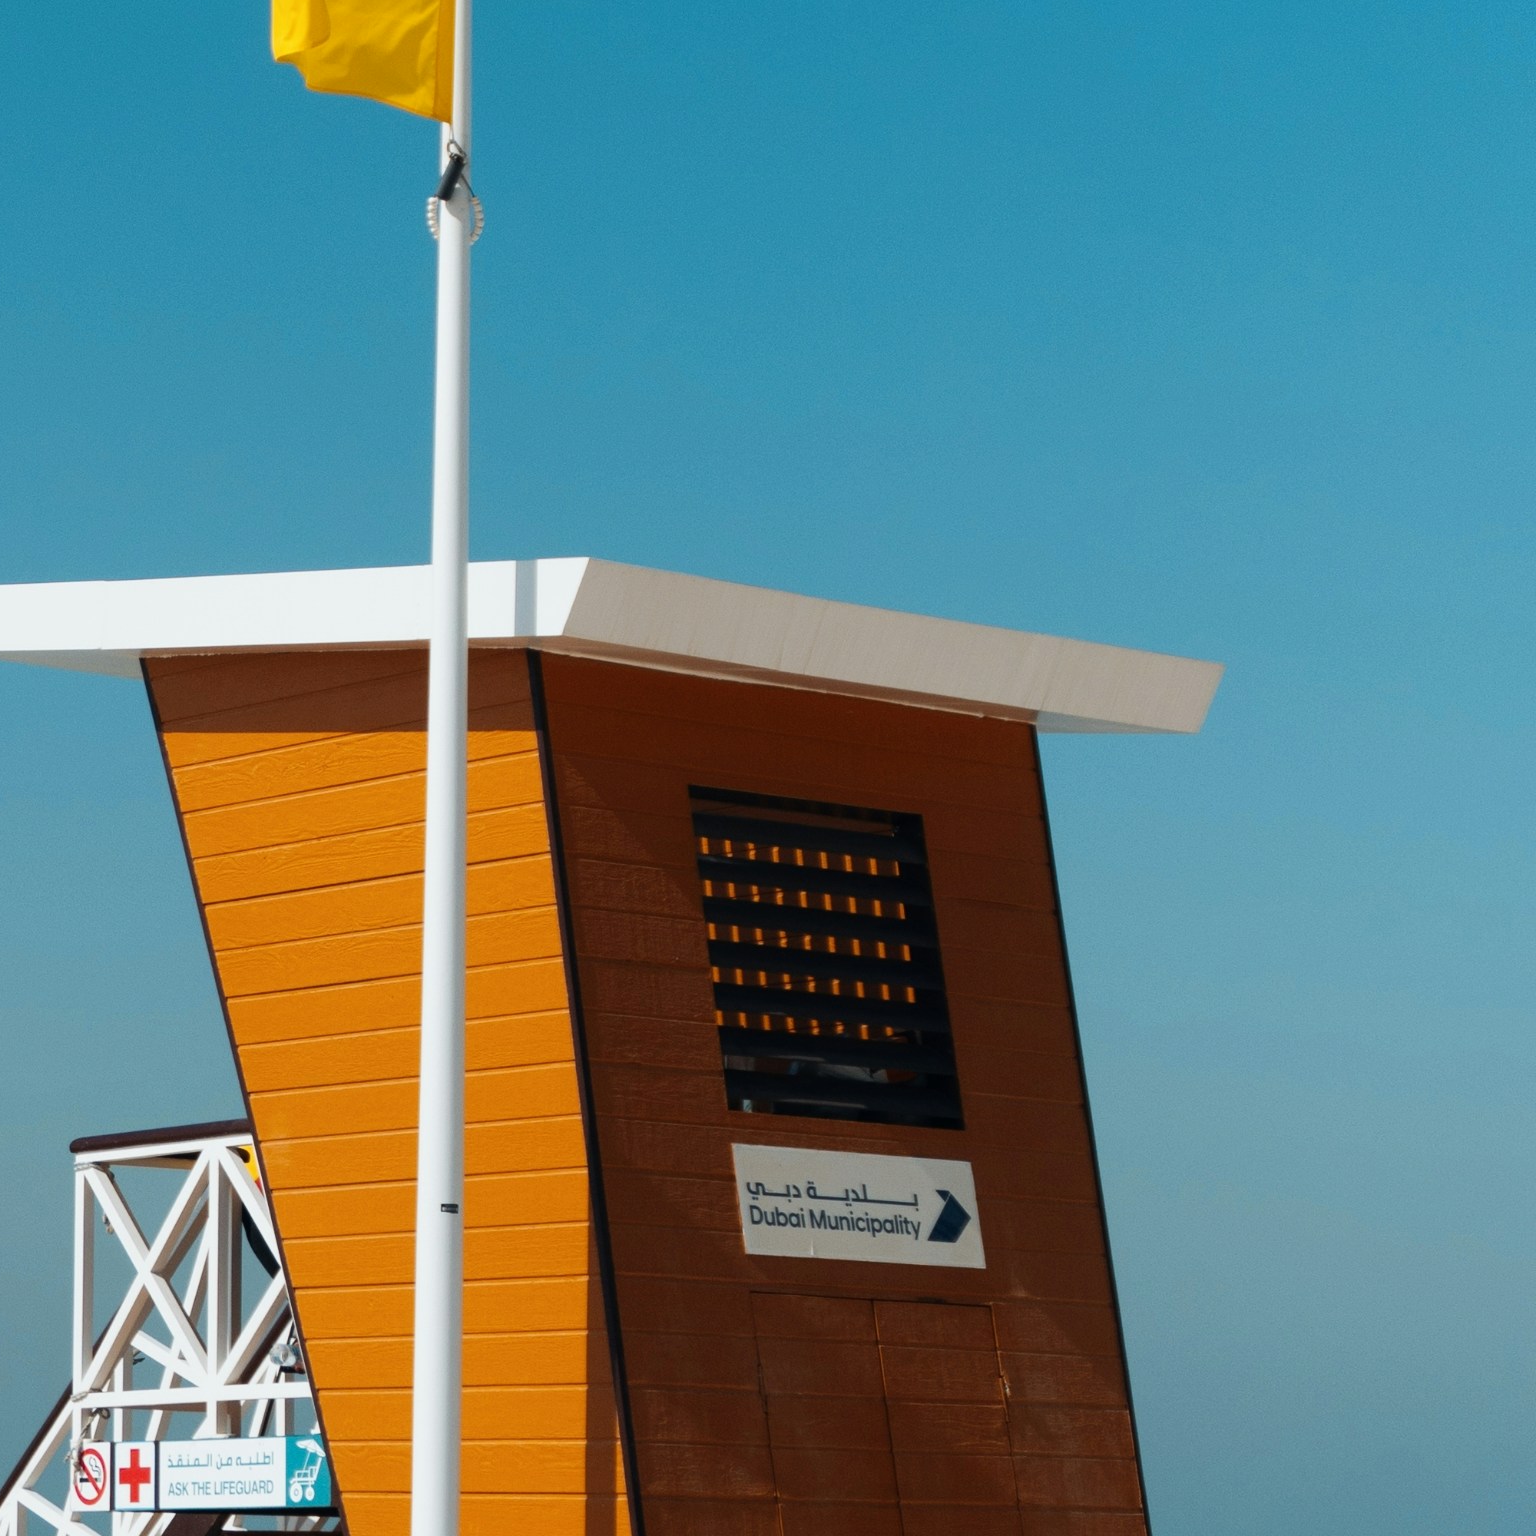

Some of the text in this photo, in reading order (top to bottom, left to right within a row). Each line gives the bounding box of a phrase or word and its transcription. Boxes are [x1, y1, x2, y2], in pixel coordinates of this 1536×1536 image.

[746, 1180, 921, 1212] بلدية دبي
[749, 1204, 922, 1241] Dubai Municipality
[167, 1453, 213, 1468] المنقذ
[216, 1453, 233, 1470] من
[168, 1479, 275, 1496] ASK THE LIFEGUARD
